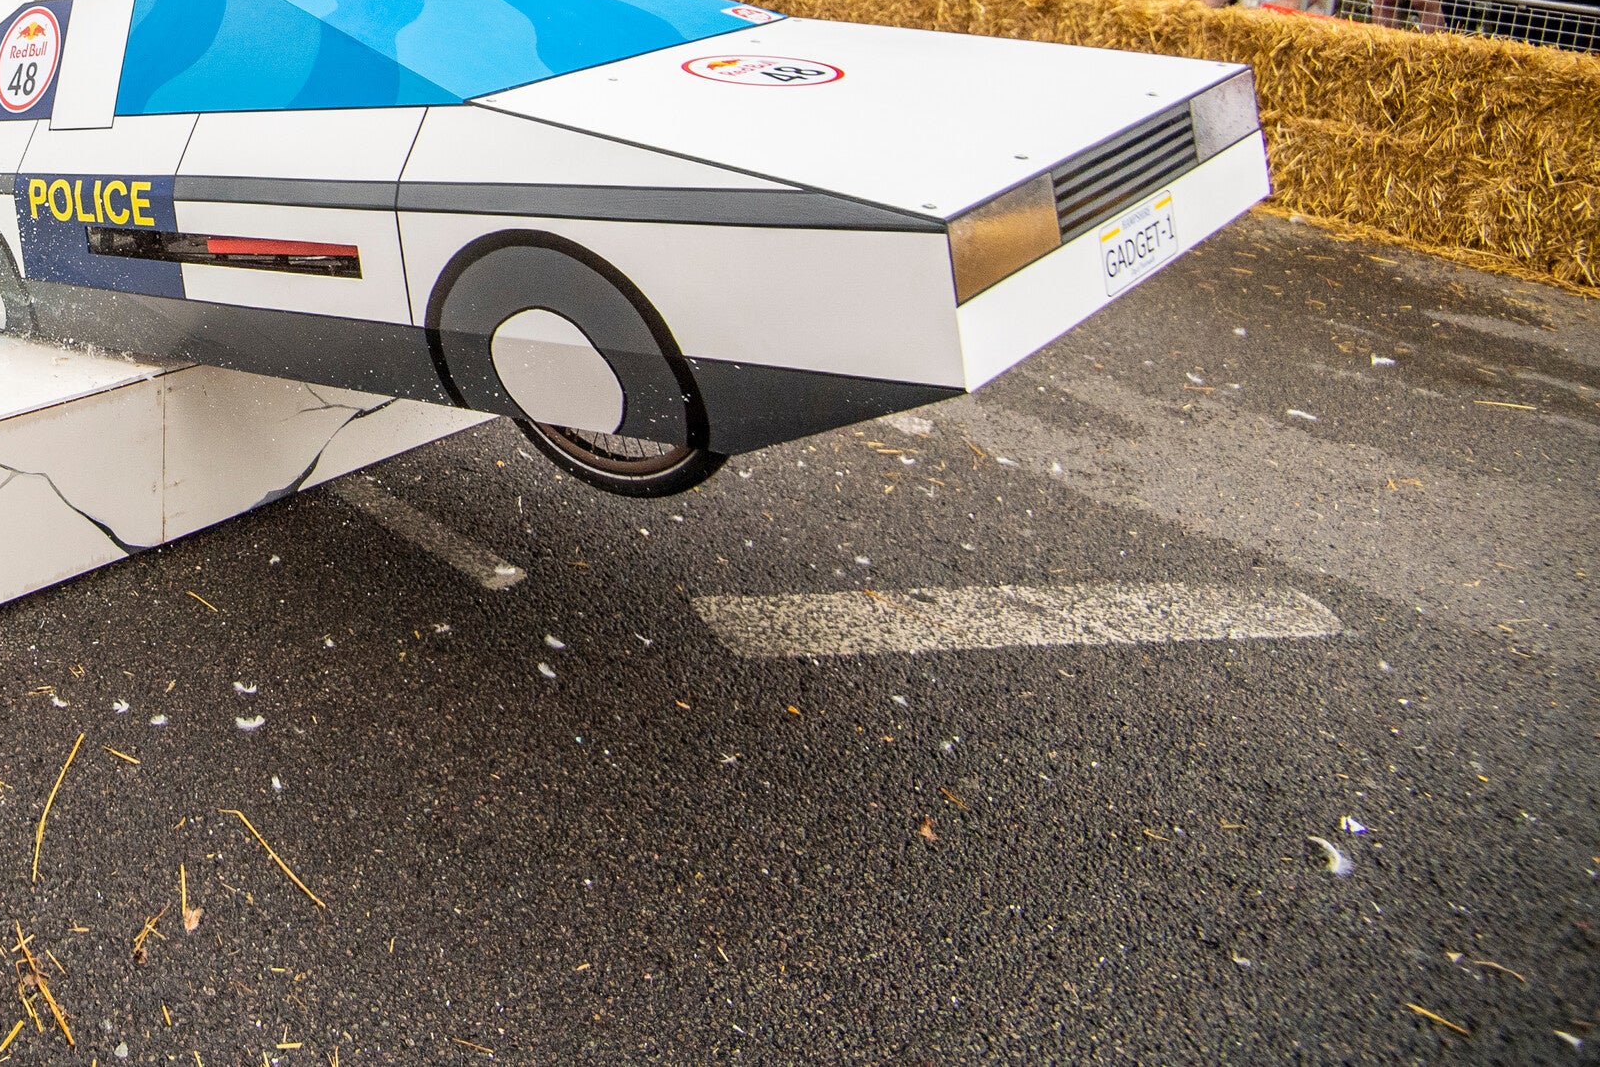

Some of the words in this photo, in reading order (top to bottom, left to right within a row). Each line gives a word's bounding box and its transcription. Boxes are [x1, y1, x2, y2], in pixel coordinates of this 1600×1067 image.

[10, 43, 30, 59] Red
[29, 41, 49, 57] Bull
[7, 62, 38, 96] 48
[760, 66, 826, 82] 48
[28, 178, 155, 227] POLICE
[1105, 214, 1175, 278] GADGET-1
